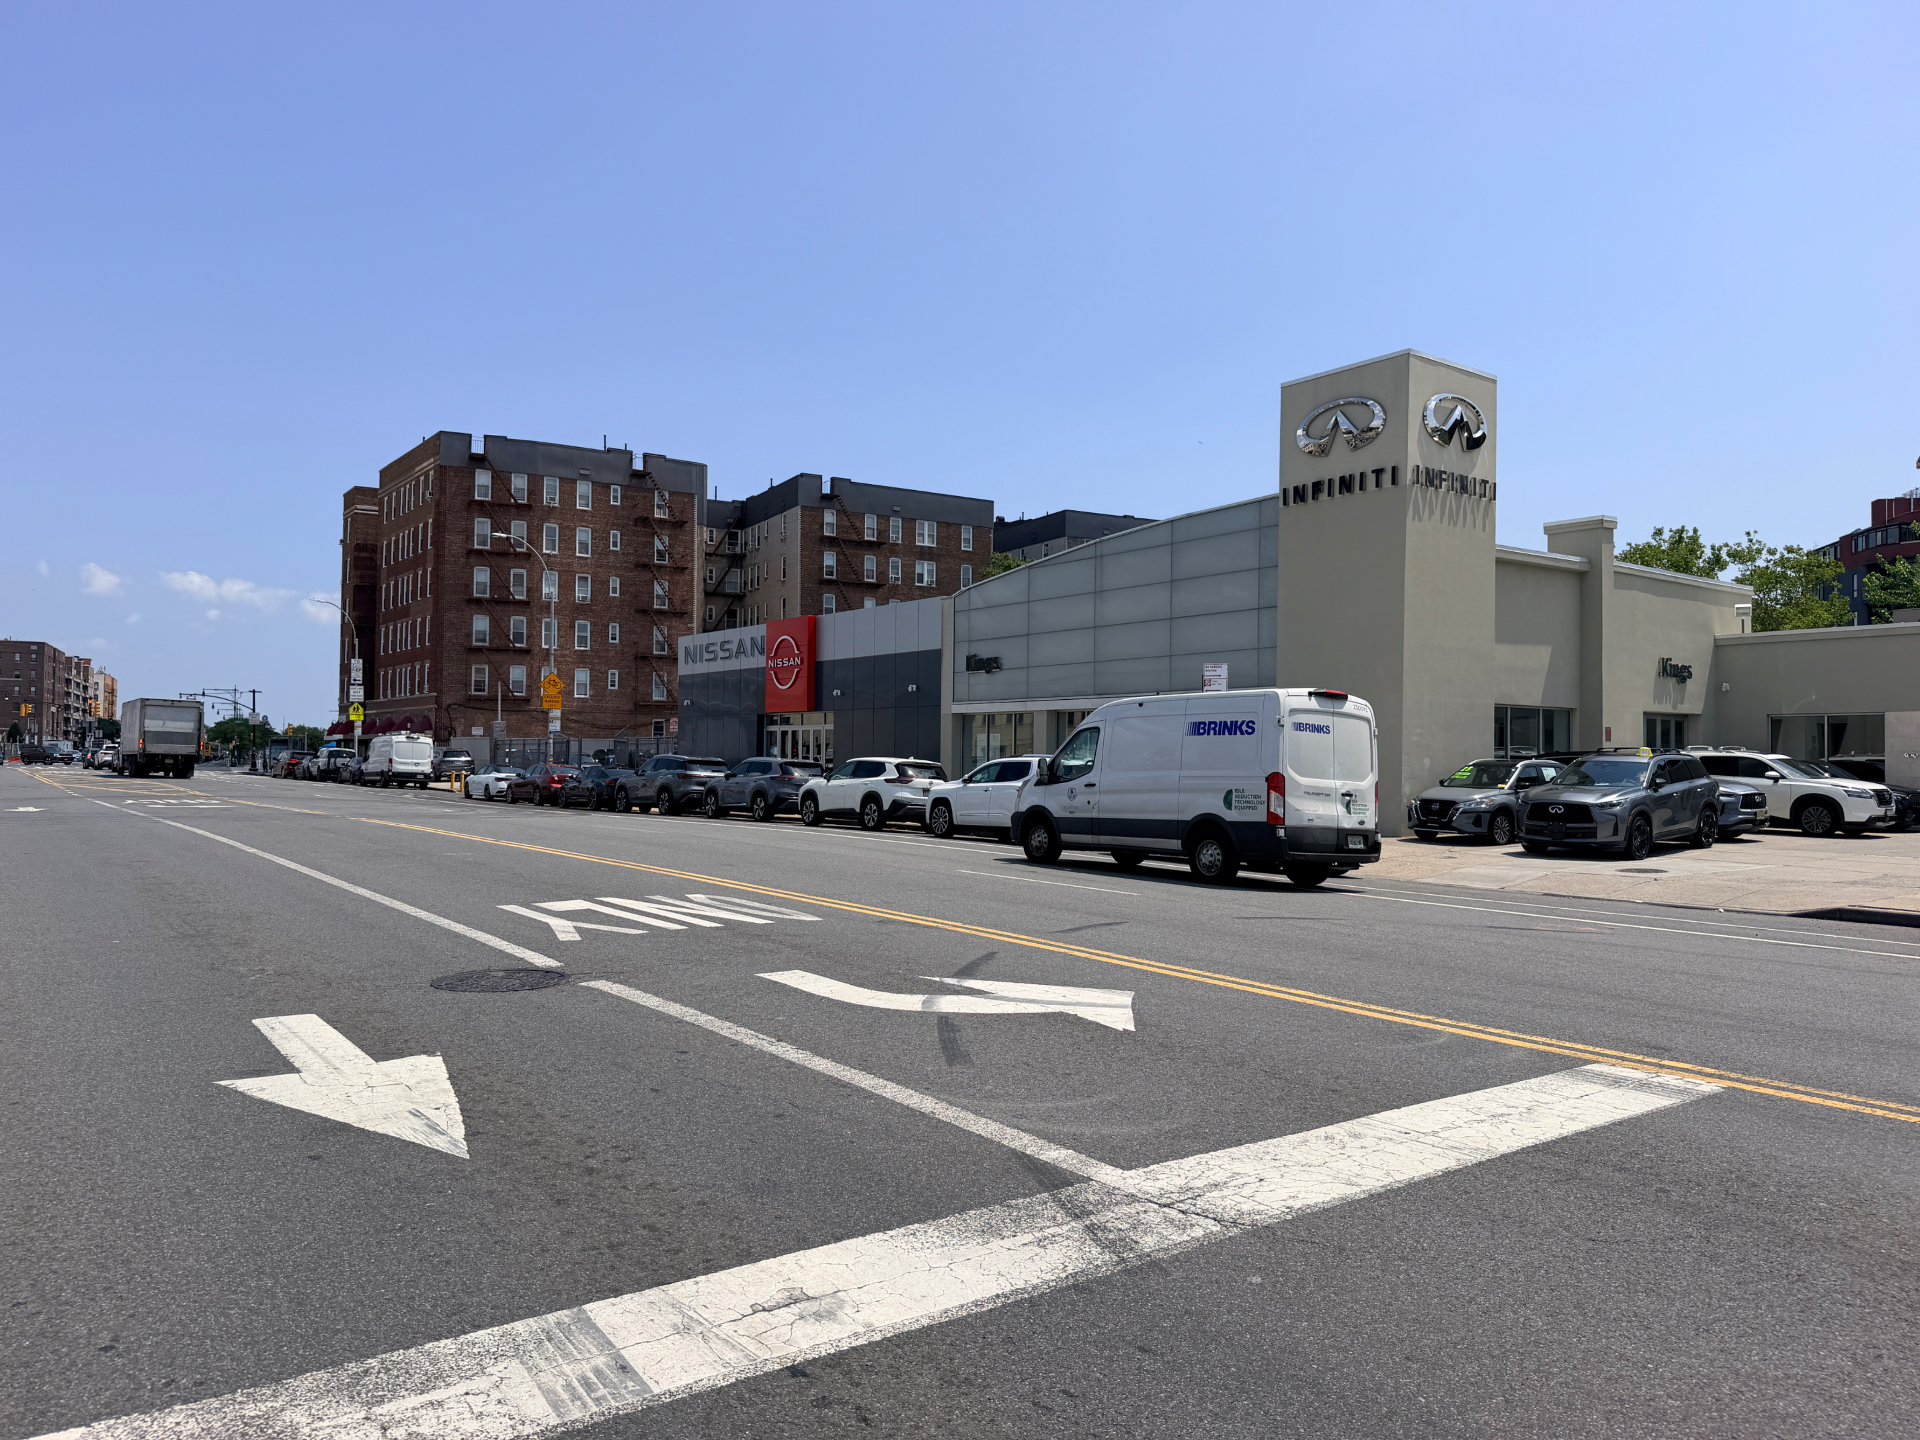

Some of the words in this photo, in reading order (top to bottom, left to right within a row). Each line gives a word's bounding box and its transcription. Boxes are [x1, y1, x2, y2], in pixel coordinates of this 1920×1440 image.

[1282, 465, 1399, 506] INFINITI
[1411, 464, 1497, 502] INFINITI
[684, 635, 766, 665] NISSAN
[768, 656, 801, 668] NISSAN
[966, 654, 1002, 674] Kings
[1658, 657, 1693, 683] Kings
[1196, 720, 1256, 736] BRINKS
[1299, 722, 1331, 734] BRINKS
[496, 894, 824, 941] ONLY
